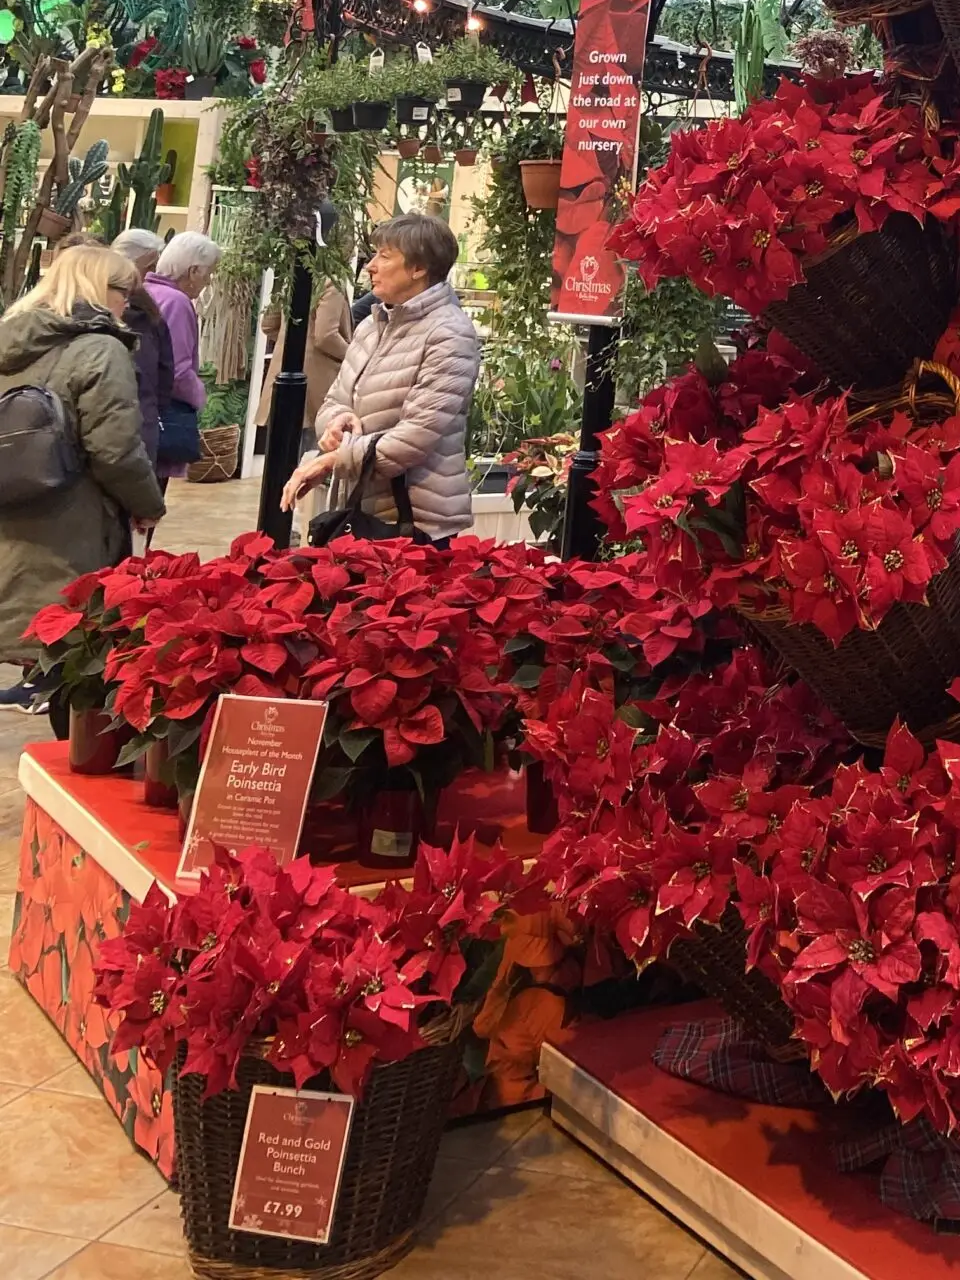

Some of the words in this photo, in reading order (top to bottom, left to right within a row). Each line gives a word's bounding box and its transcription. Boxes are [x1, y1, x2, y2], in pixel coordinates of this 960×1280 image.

[589, 50, 627, 64] Grown
[578, 72, 600, 88] just
[602, 72, 633, 85] down
[573, 94, 592, 107] the
[594, 94, 621, 107] road
[624, 96, 636, 107] at
[579, 118, 599, 129] our
[602, 118, 626, 129] own
[578, 139, 623, 154] nursery
[565, 276, 611, 294] Christmas
[247, 737, 283, 747] November
[222, 745, 259, 757] Houseplant
[260, 749, 268, 757] of
[269, 750, 280, 758] the
[281, 751, 303, 760] Month
[230, 760, 259, 776] Early
[262, 762, 286, 777] Bird
[226, 774, 282, 792] Poinsettia
[234, 793, 262, 804] Ceramic
[263, 795, 275, 805] Pot
[258, 1132, 280, 1145] Red
[282, 1136, 301, 1148] and
[304, 1138, 331, 1151] Gold
[266, 1147, 317, 1164] Poinsettia
[273, 1161, 306, 1176] Bunch
[263, 1200, 303, 1218] £7.99
